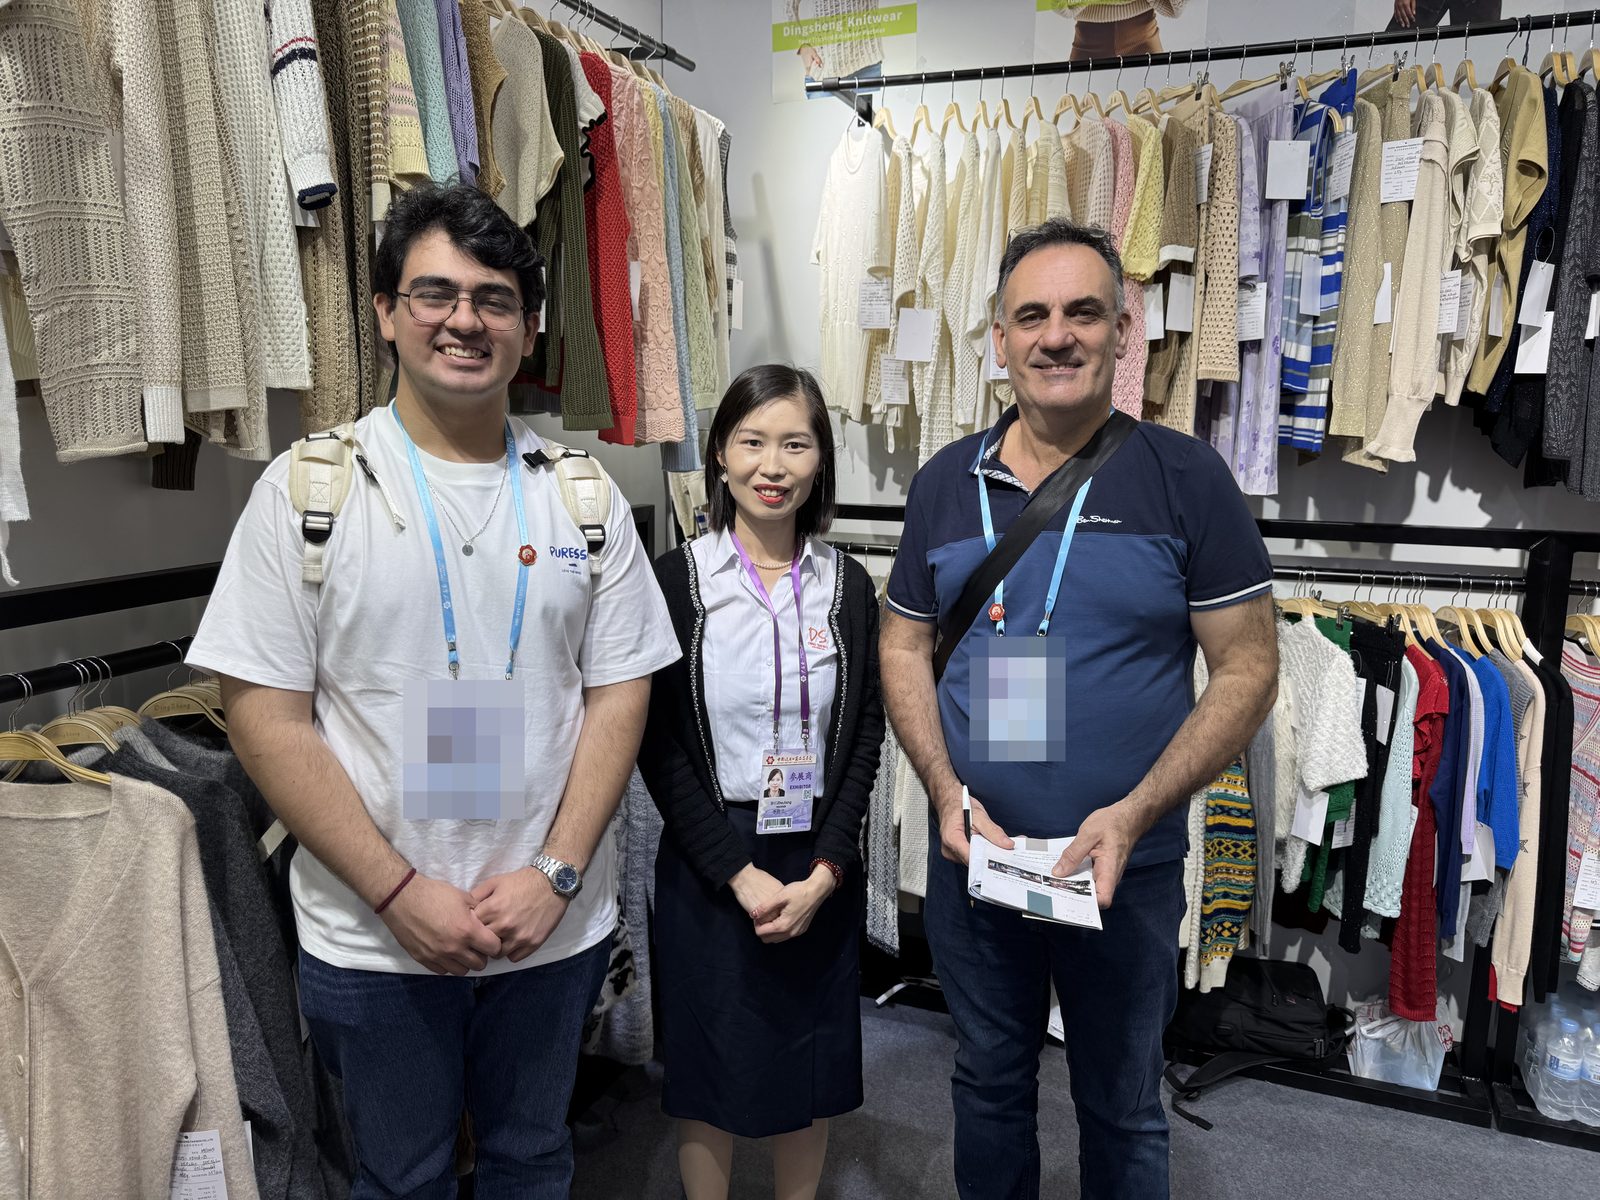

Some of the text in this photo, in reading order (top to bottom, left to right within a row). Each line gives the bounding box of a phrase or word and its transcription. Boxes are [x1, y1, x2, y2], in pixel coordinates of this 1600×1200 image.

[783, 12, 903, 37] Dingsheng Knitwear
[549, 546, 587, 560] PURESS
[808, 626, 827, 644] DS
